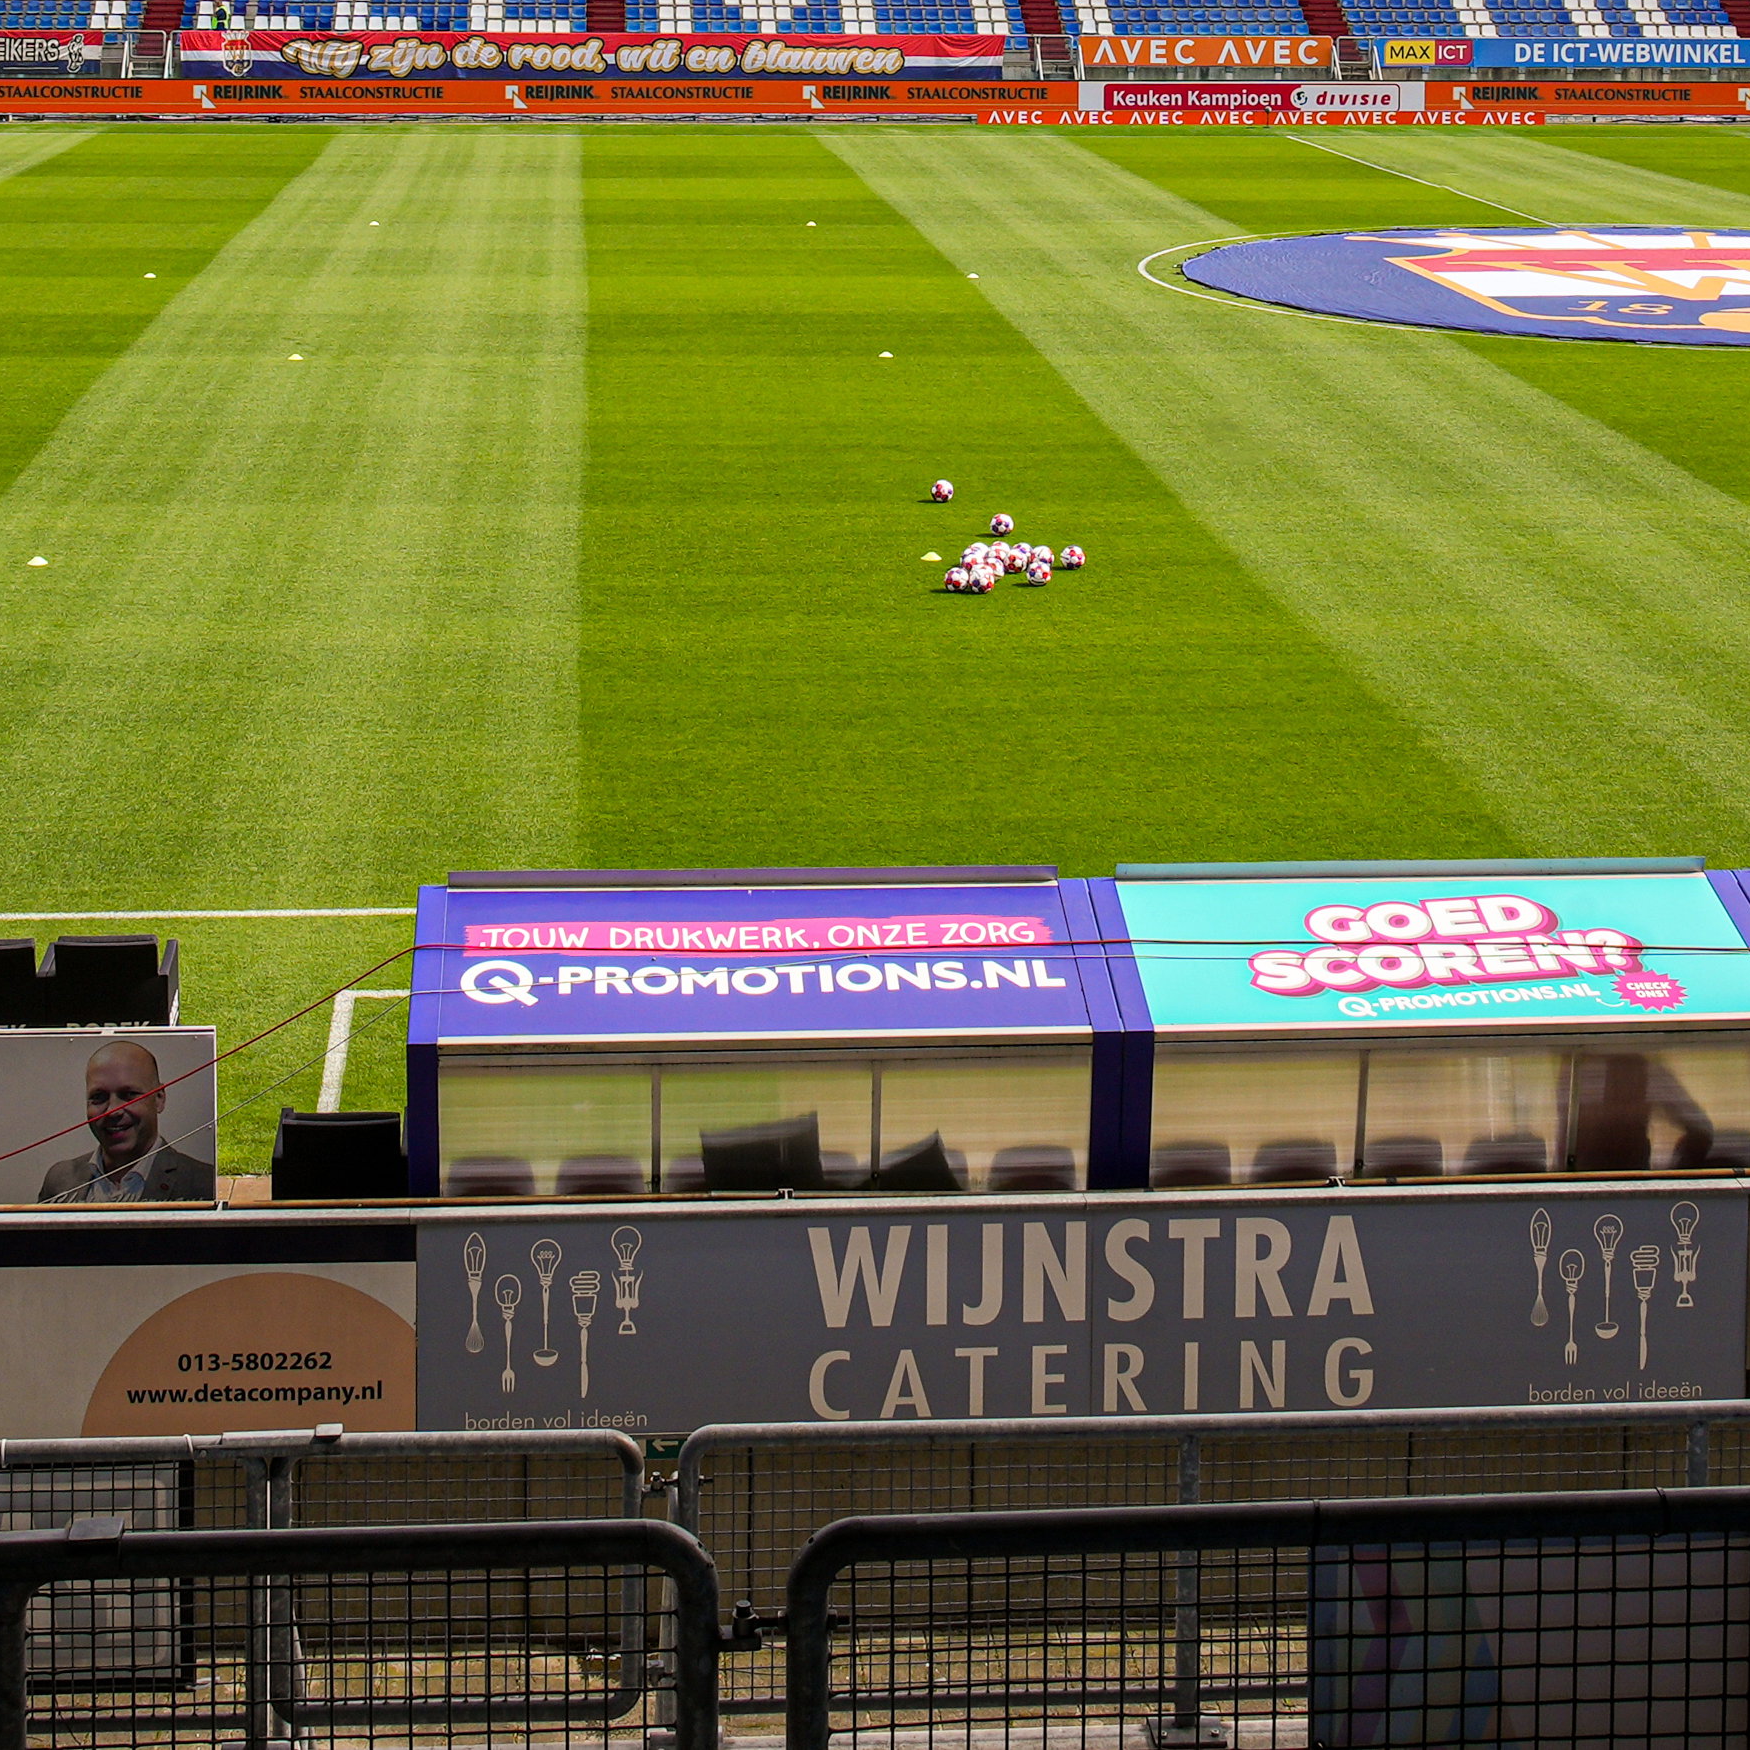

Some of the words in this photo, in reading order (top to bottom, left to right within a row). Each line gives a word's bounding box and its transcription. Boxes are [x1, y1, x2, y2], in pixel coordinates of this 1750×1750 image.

[367, 38, 449, 78] zijn
[451, 36, 507, 71] de
[507, 38, 608, 75] rood,
[616, 38, 682, 74] wit
[682, 41, 739, 75] en
[739, 36, 906, 76] blauwen
[1390, 45, 1431, 61] MAX
[1437, 45, 1468, 61] ICT
[1514, 43, 1545, 63] DE
[1552, 42, 1746, 65] ICT-WEBWINKEL
[821, 85, 891, 100] REIJRINK
[906, 86, 1048, 101] STAALCONSTRUCTIE
[1112, 88, 1183, 107] Keuken
[1187, 88, 1283, 111] Kampioen
[1315, 89, 1393, 108] divisie
[1273, 110, 1327, 125] AVEC
[1306, 895, 1543, 944] GOED
[479, 926, 590, 952] JOUW
[608, 925, 821, 952] DRUKWERK,
[827, 922, 928, 950] ONZE
[939, 919, 1036, 946] ZORG
[1252, 926, 1635, 990] SCOREN?
[459, 958, 1067, 1007] Q-PROMOTIONS.NL
[1625, 981, 1672, 991] CHECK
[1635, 990, 1670, 999] ONS!
[806, 1214, 1375, 1328] WIJNSTRA
[176, 1351, 333, 1374] 013-5802262
[807, 1335, 1375, 1421] CATERING
[126, 1379, 384, 1408] www.detacompany.nl
[1528, 1381, 1596, 1404] borden
[1602, 1382, 1630, 1402] vol
[1635, 1379, 1704, 1401] ideeën
[464, 1409, 536, 1432] borden
[542, 1409, 572, 1430] vol
[578, 1407, 649, 1430] ideeën
